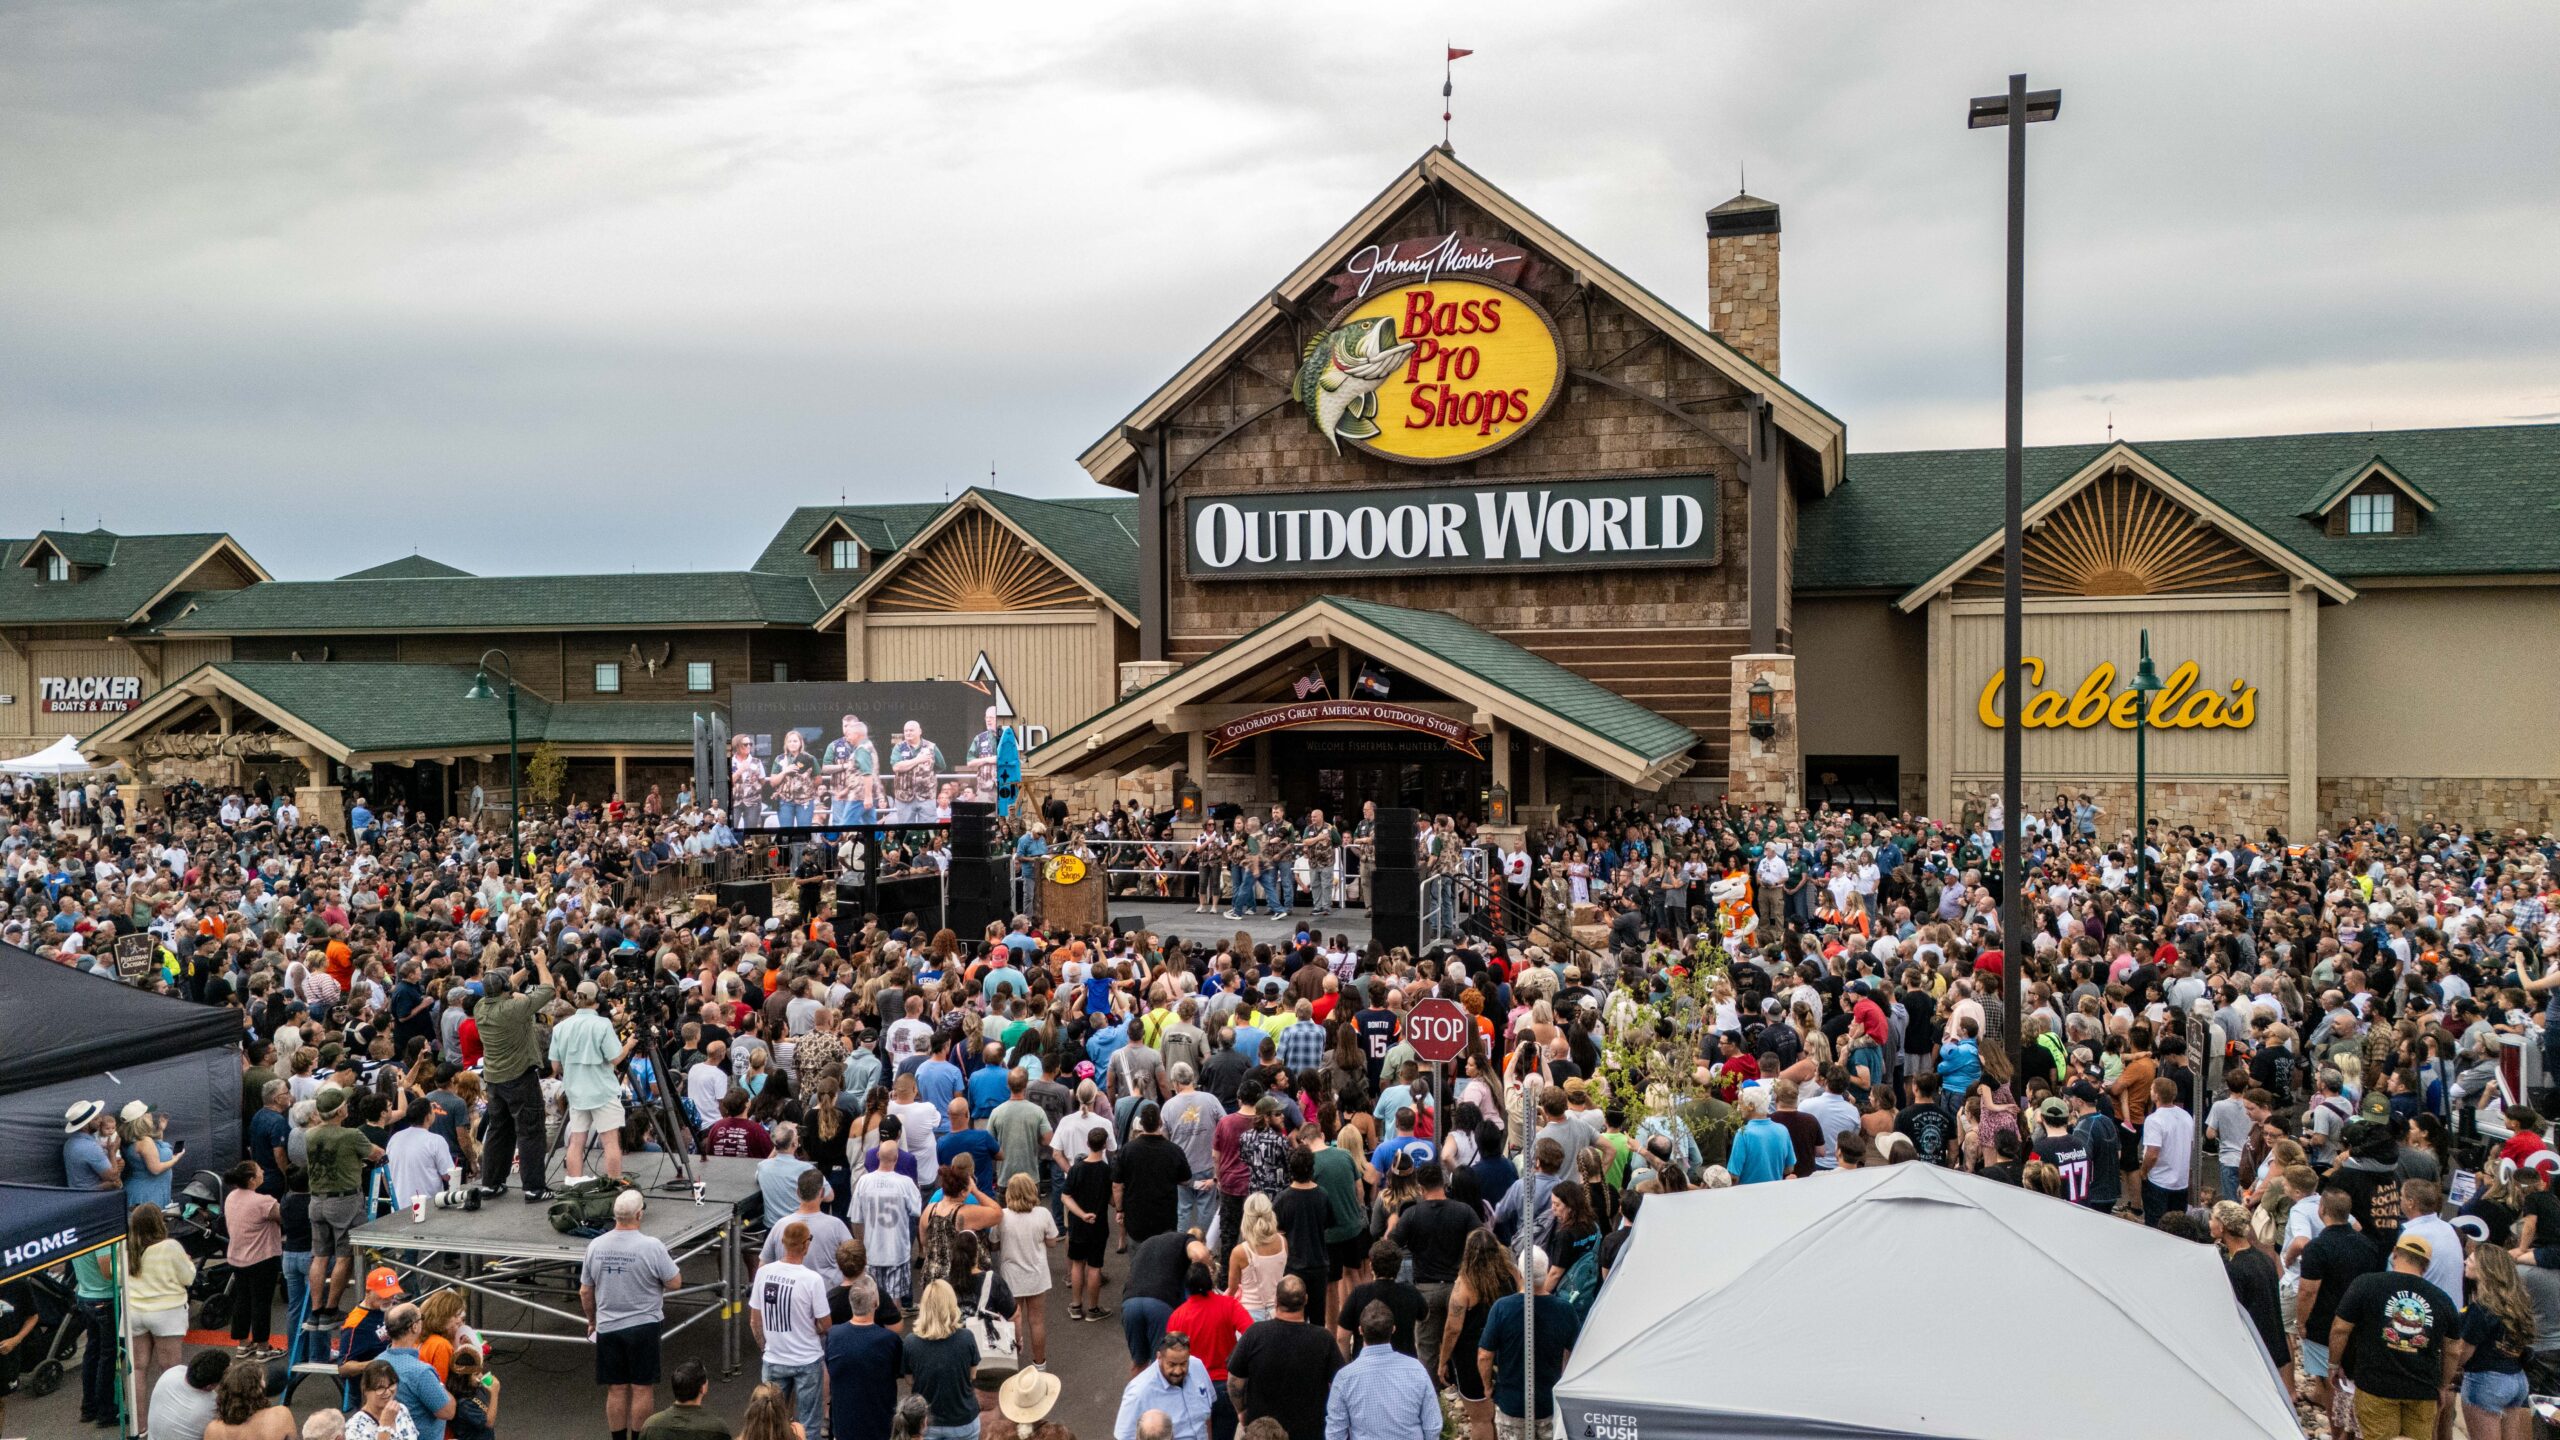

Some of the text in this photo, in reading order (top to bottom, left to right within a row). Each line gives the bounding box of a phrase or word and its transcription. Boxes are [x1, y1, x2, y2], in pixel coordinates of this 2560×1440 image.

[1348, 231, 1521, 297] Johnny Morris
[1399, 290, 1501, 339] Bass
[1404, 338, 1480, 384] Pro
[1404, 383, 1529, 436] Shops
[1195, 490, 1702, 569] OUTDOOR WORLD
[40, 676, 141, 700] TRACKER
[1978, 656, 2258, 729] Cabela's
[51, 701, 128, 712] BOATS & ATVs
[1227, 705, 1459, 737] COLORADO'S GREAT AMERICAN OUTDOOR STORE
[1368, 1034, 1388, 1058] 15
[1411, 1016, 1464, 1042] STOP
[2055, 1147, 2087, 1163] Disneyland
[2058, 1160, 2088, 1201] 77
[868, 1195, 899, 1229] 15
[4, 1227, 79, 1267] HOME
[1583, 1412, 1637, 1427] CENTER
[1596, 1425, 1638, 1440] PUSH
